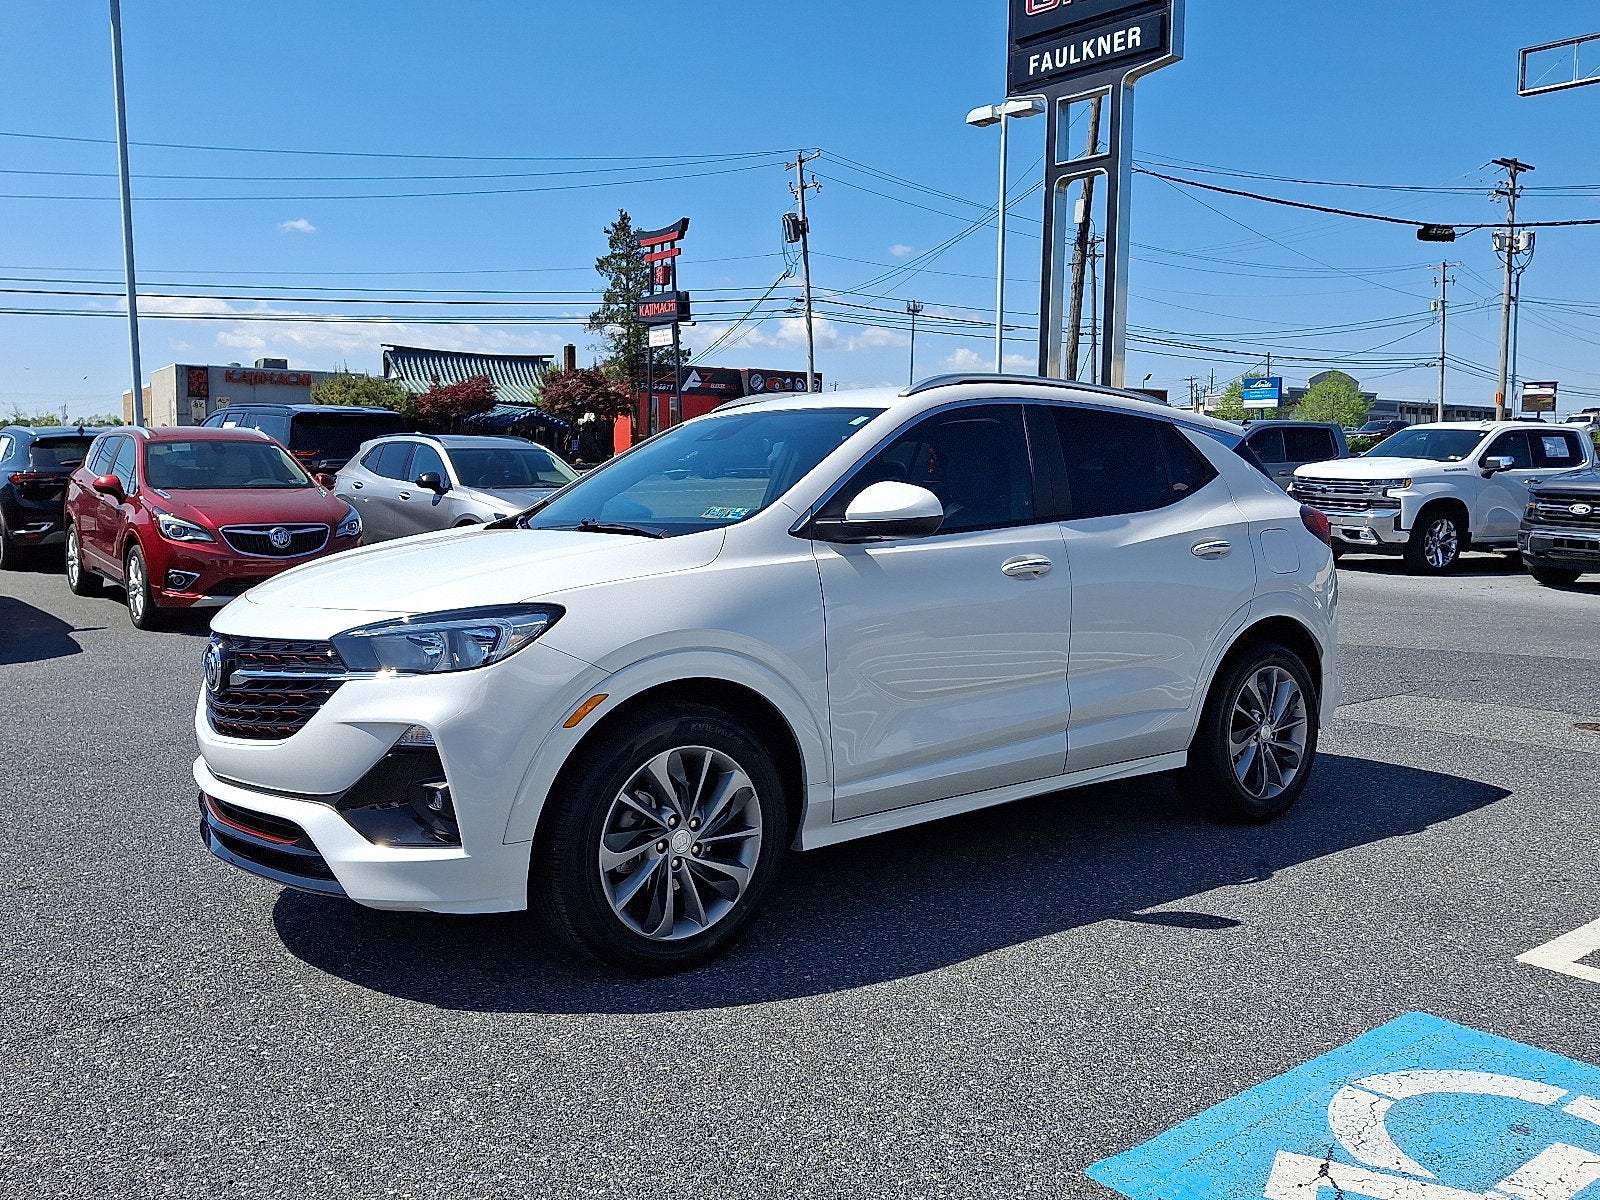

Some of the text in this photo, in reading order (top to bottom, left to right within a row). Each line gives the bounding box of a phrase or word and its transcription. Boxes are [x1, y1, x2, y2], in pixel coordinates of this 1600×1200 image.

[1029, 26, 1142, 76] FAULKNER
[638, 299, 676, 317] KAJIMACHI
[224, 369, 312, 387] KAJIMACHI
